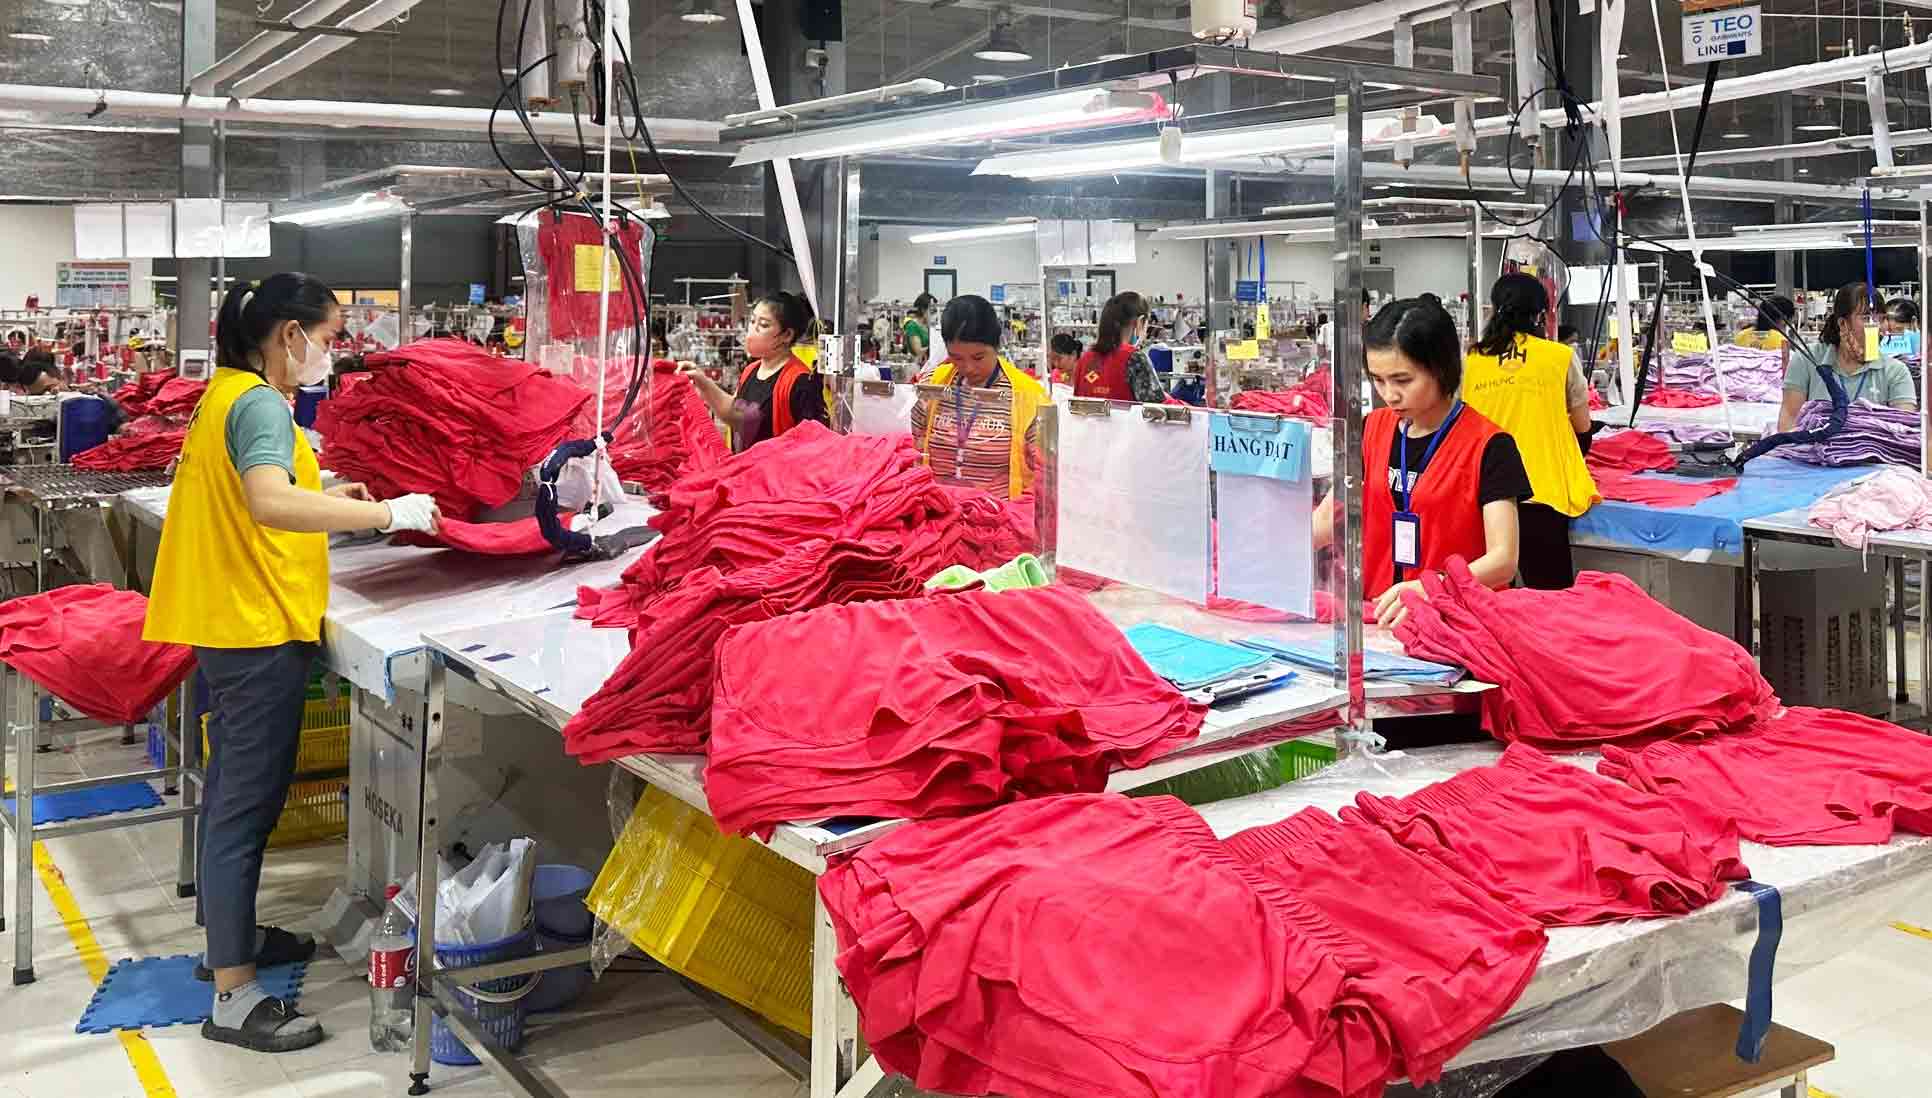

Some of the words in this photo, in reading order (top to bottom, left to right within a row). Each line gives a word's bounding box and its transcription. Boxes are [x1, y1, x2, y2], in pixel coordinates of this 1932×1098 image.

[1711, 15, 1752, 33] TEO
[1698, 43, 1726, 57] LINE
[1215, 432, 1261, 457] HÀNG
[1264, 440, 1293, 462] ĐẠT
[364, 785, 404, 840] HOSEKA
